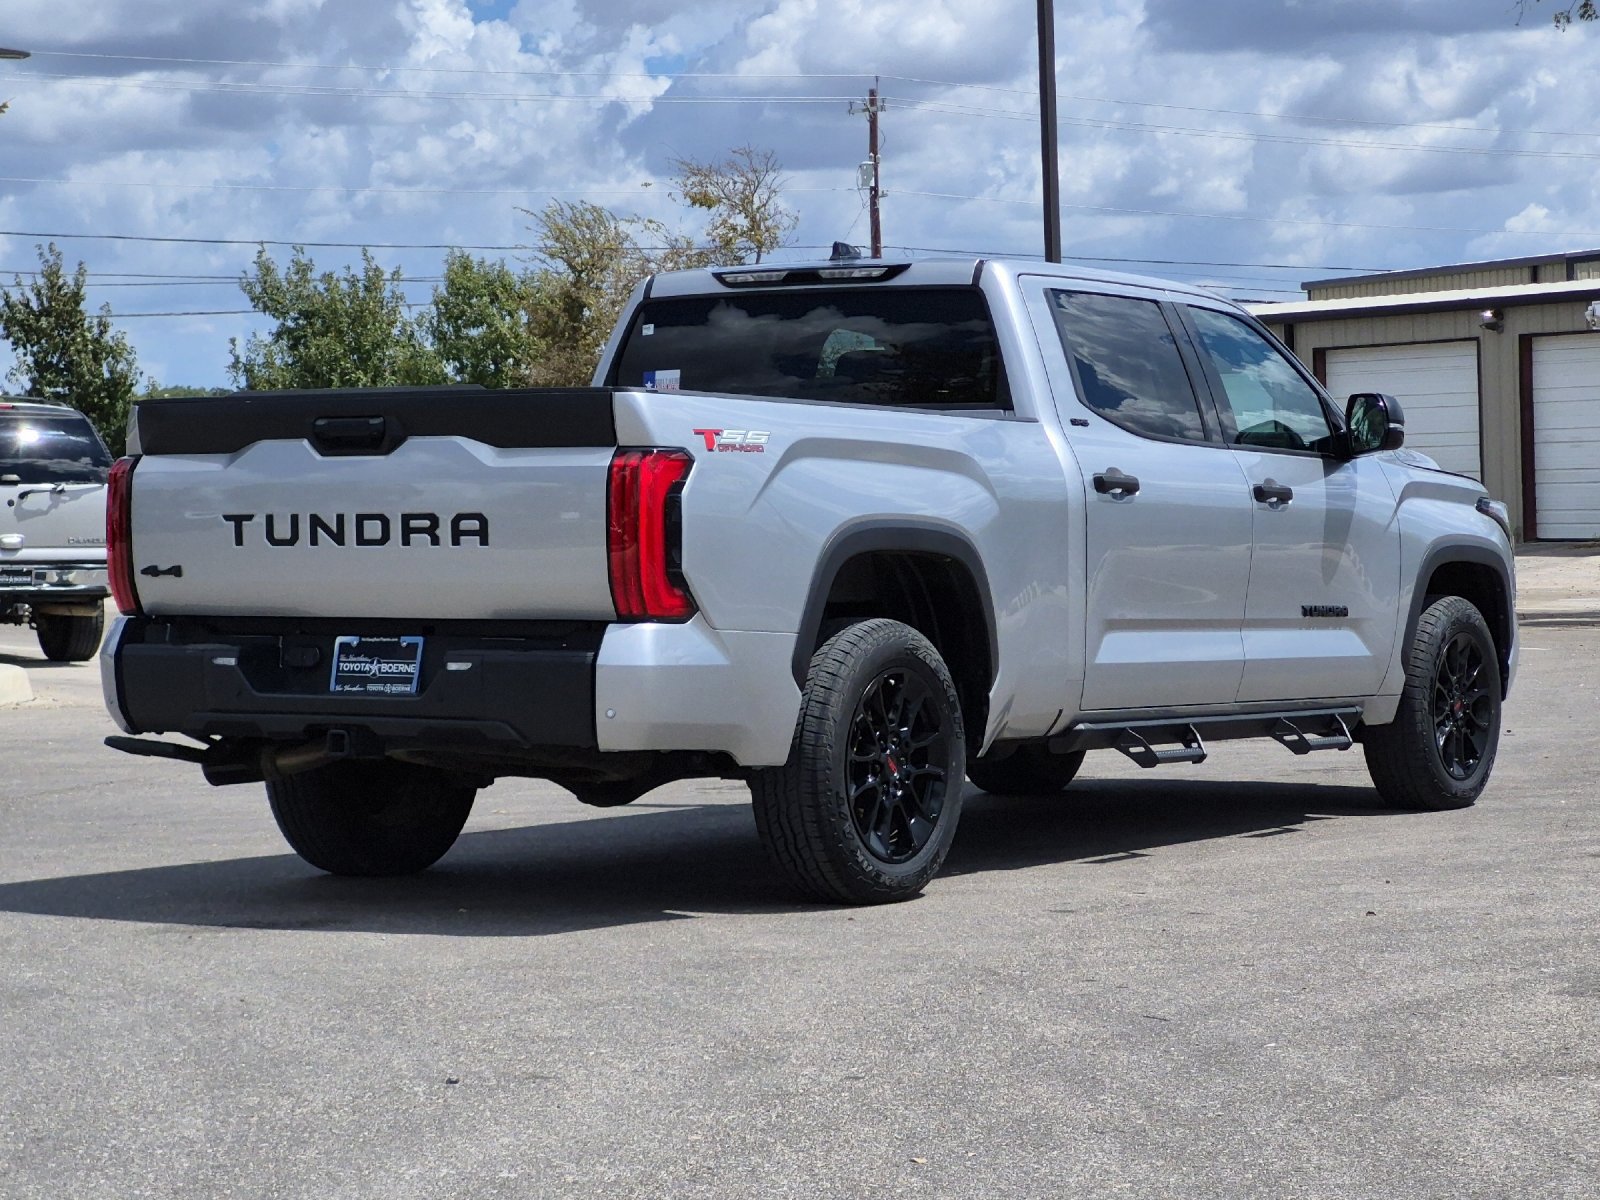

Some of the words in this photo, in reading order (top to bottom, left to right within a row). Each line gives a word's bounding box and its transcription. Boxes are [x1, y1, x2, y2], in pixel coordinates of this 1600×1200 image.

[222, 513, 489, 547] TUNDRA
[1301, 605, 1349, 617] TUNDRA
[339, 662, 370, 671] TOYOTA
[381, 663, 416, 673] BOERNE
